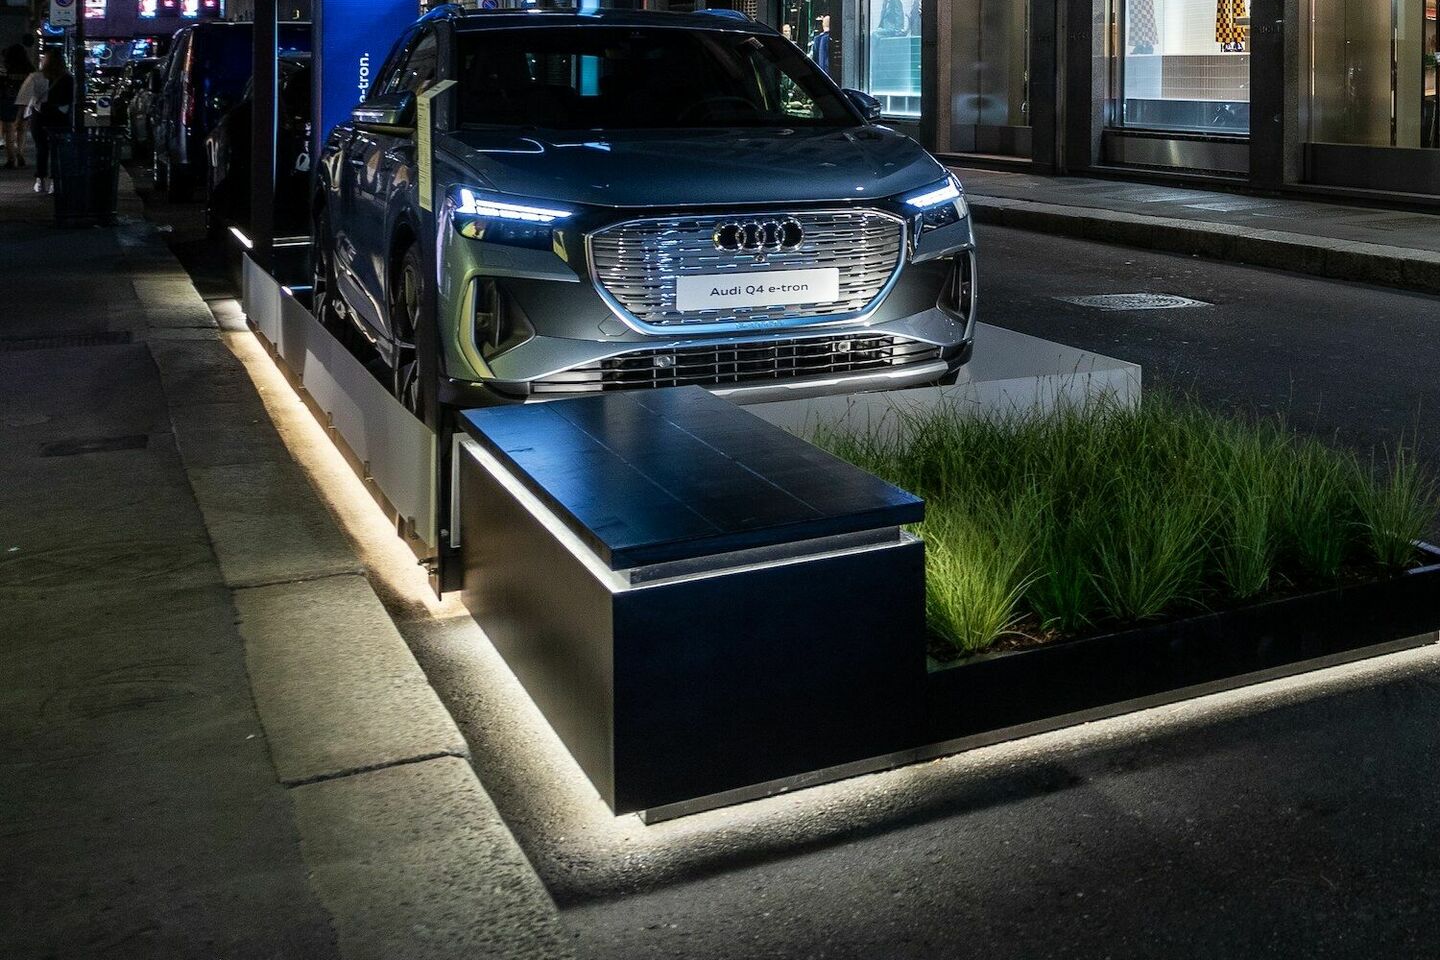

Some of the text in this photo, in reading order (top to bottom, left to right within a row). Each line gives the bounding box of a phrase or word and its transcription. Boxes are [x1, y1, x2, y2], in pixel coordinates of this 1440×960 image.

[710, 283, 809, 297] Audi Q4 e-tron
